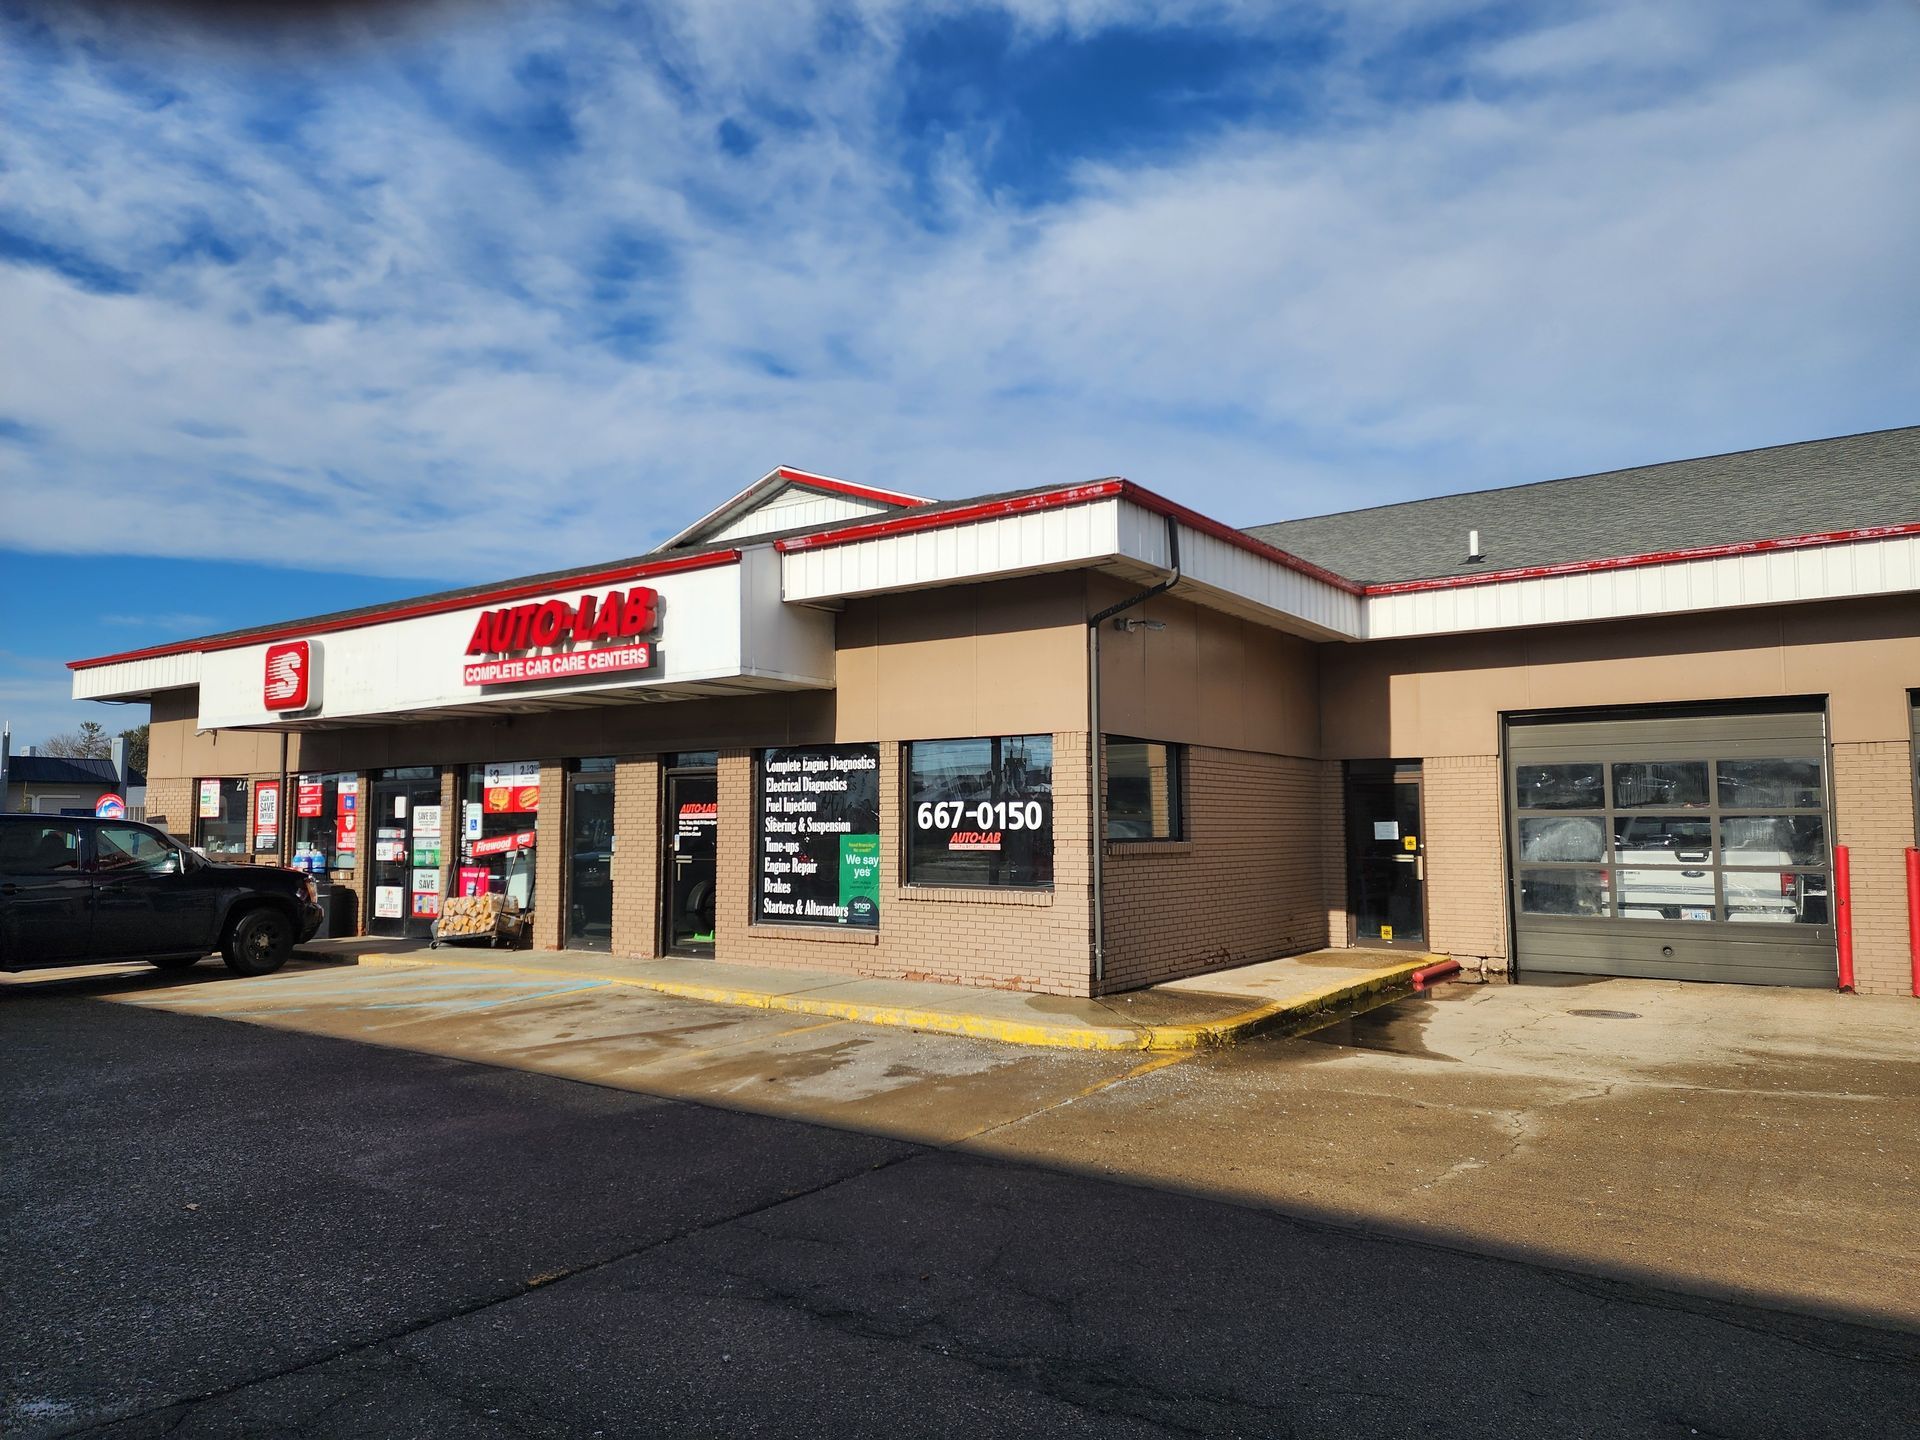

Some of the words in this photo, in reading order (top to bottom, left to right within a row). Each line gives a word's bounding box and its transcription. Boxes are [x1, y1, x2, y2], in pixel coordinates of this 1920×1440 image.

[465, 587, 657, 655] AUTO-LAB
[465, 662, 524, 682] COMPLETE
[525, 658, 551, 676] CAR
[552, 654, 587, 673] CARE
[588, 648, 647, 669] CENTERS
[766, 758, 801, 774] Complete
[802, 756, 829, 773] Engine
[830, 754, 876, 772] Diagnostics
[766, 776, 802, 792] Electrical
[802, 776, 848, 793] Diagnostics
[259, 802, 274, 812] SAVE
[766, 797, 783, 812] Fuel
[783, 797, 817, 814] Injection
[418, 811, 429, 820] SAVE
[917, 801, 1043, 830] 667-0150
[765, 817, 797, 834] Steering
[797, 817, 806, 832] &
[806, 817, 851, 835] Suspension
[476, 837, 512, 853] Firewood
[765, 836, 800, 855] Tune-ups
[765, 857, 791, 875] Engine
[792, 857, 818, 876] Repair
[845, 854, 862, 865] We
[863, 856, 879, 867] say
[853, 868, 871, 879] yes
[418, 880, 434, 890] SAVE
[764, 877, 791, 893] Brakes
[763, 898, 795, 915] Starters
[795, 899, 804, 915] &
[804, 899, 849, 917] Alternators
